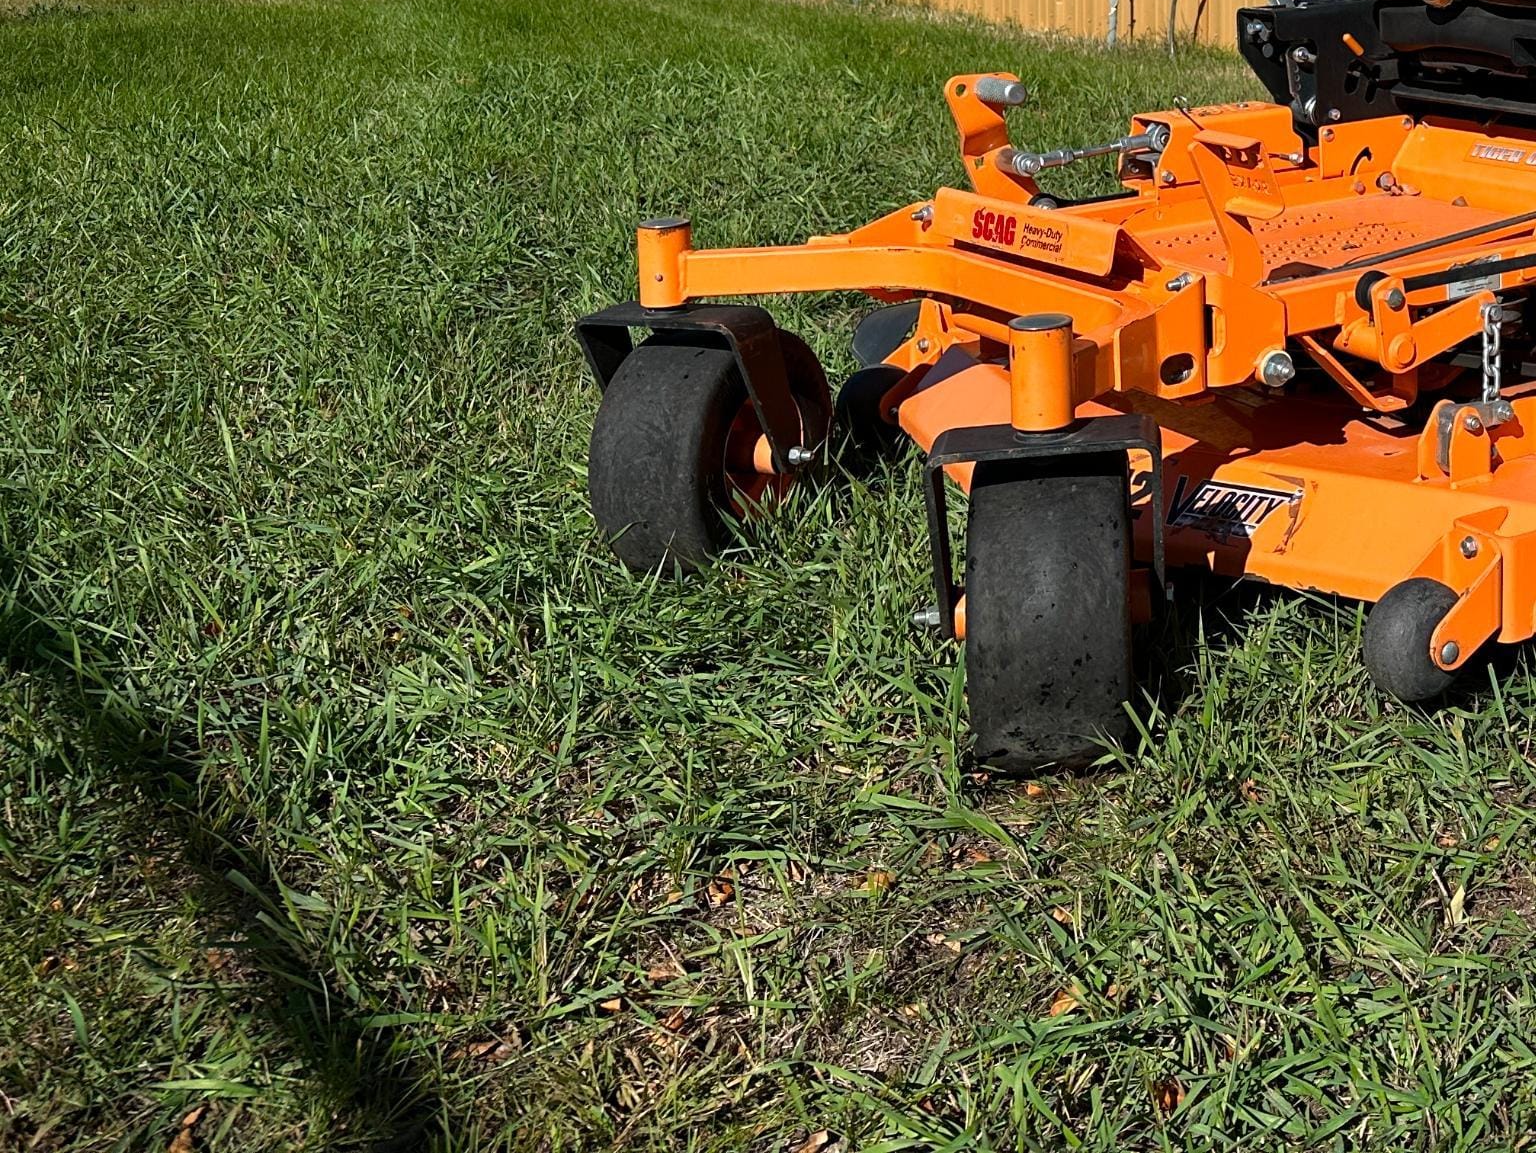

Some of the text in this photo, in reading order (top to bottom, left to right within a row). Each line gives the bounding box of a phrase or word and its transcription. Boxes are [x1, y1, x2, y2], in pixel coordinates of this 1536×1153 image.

[1471, 144, 1526, 163] TIGER
[972, 207, 1017, 246] SCAG
[1023, 222, 1063, 243] Heavy-Duty
[1020, 235, 1063, 254] Commercial
[1166, 474, 1285, 527] VELOCITY
